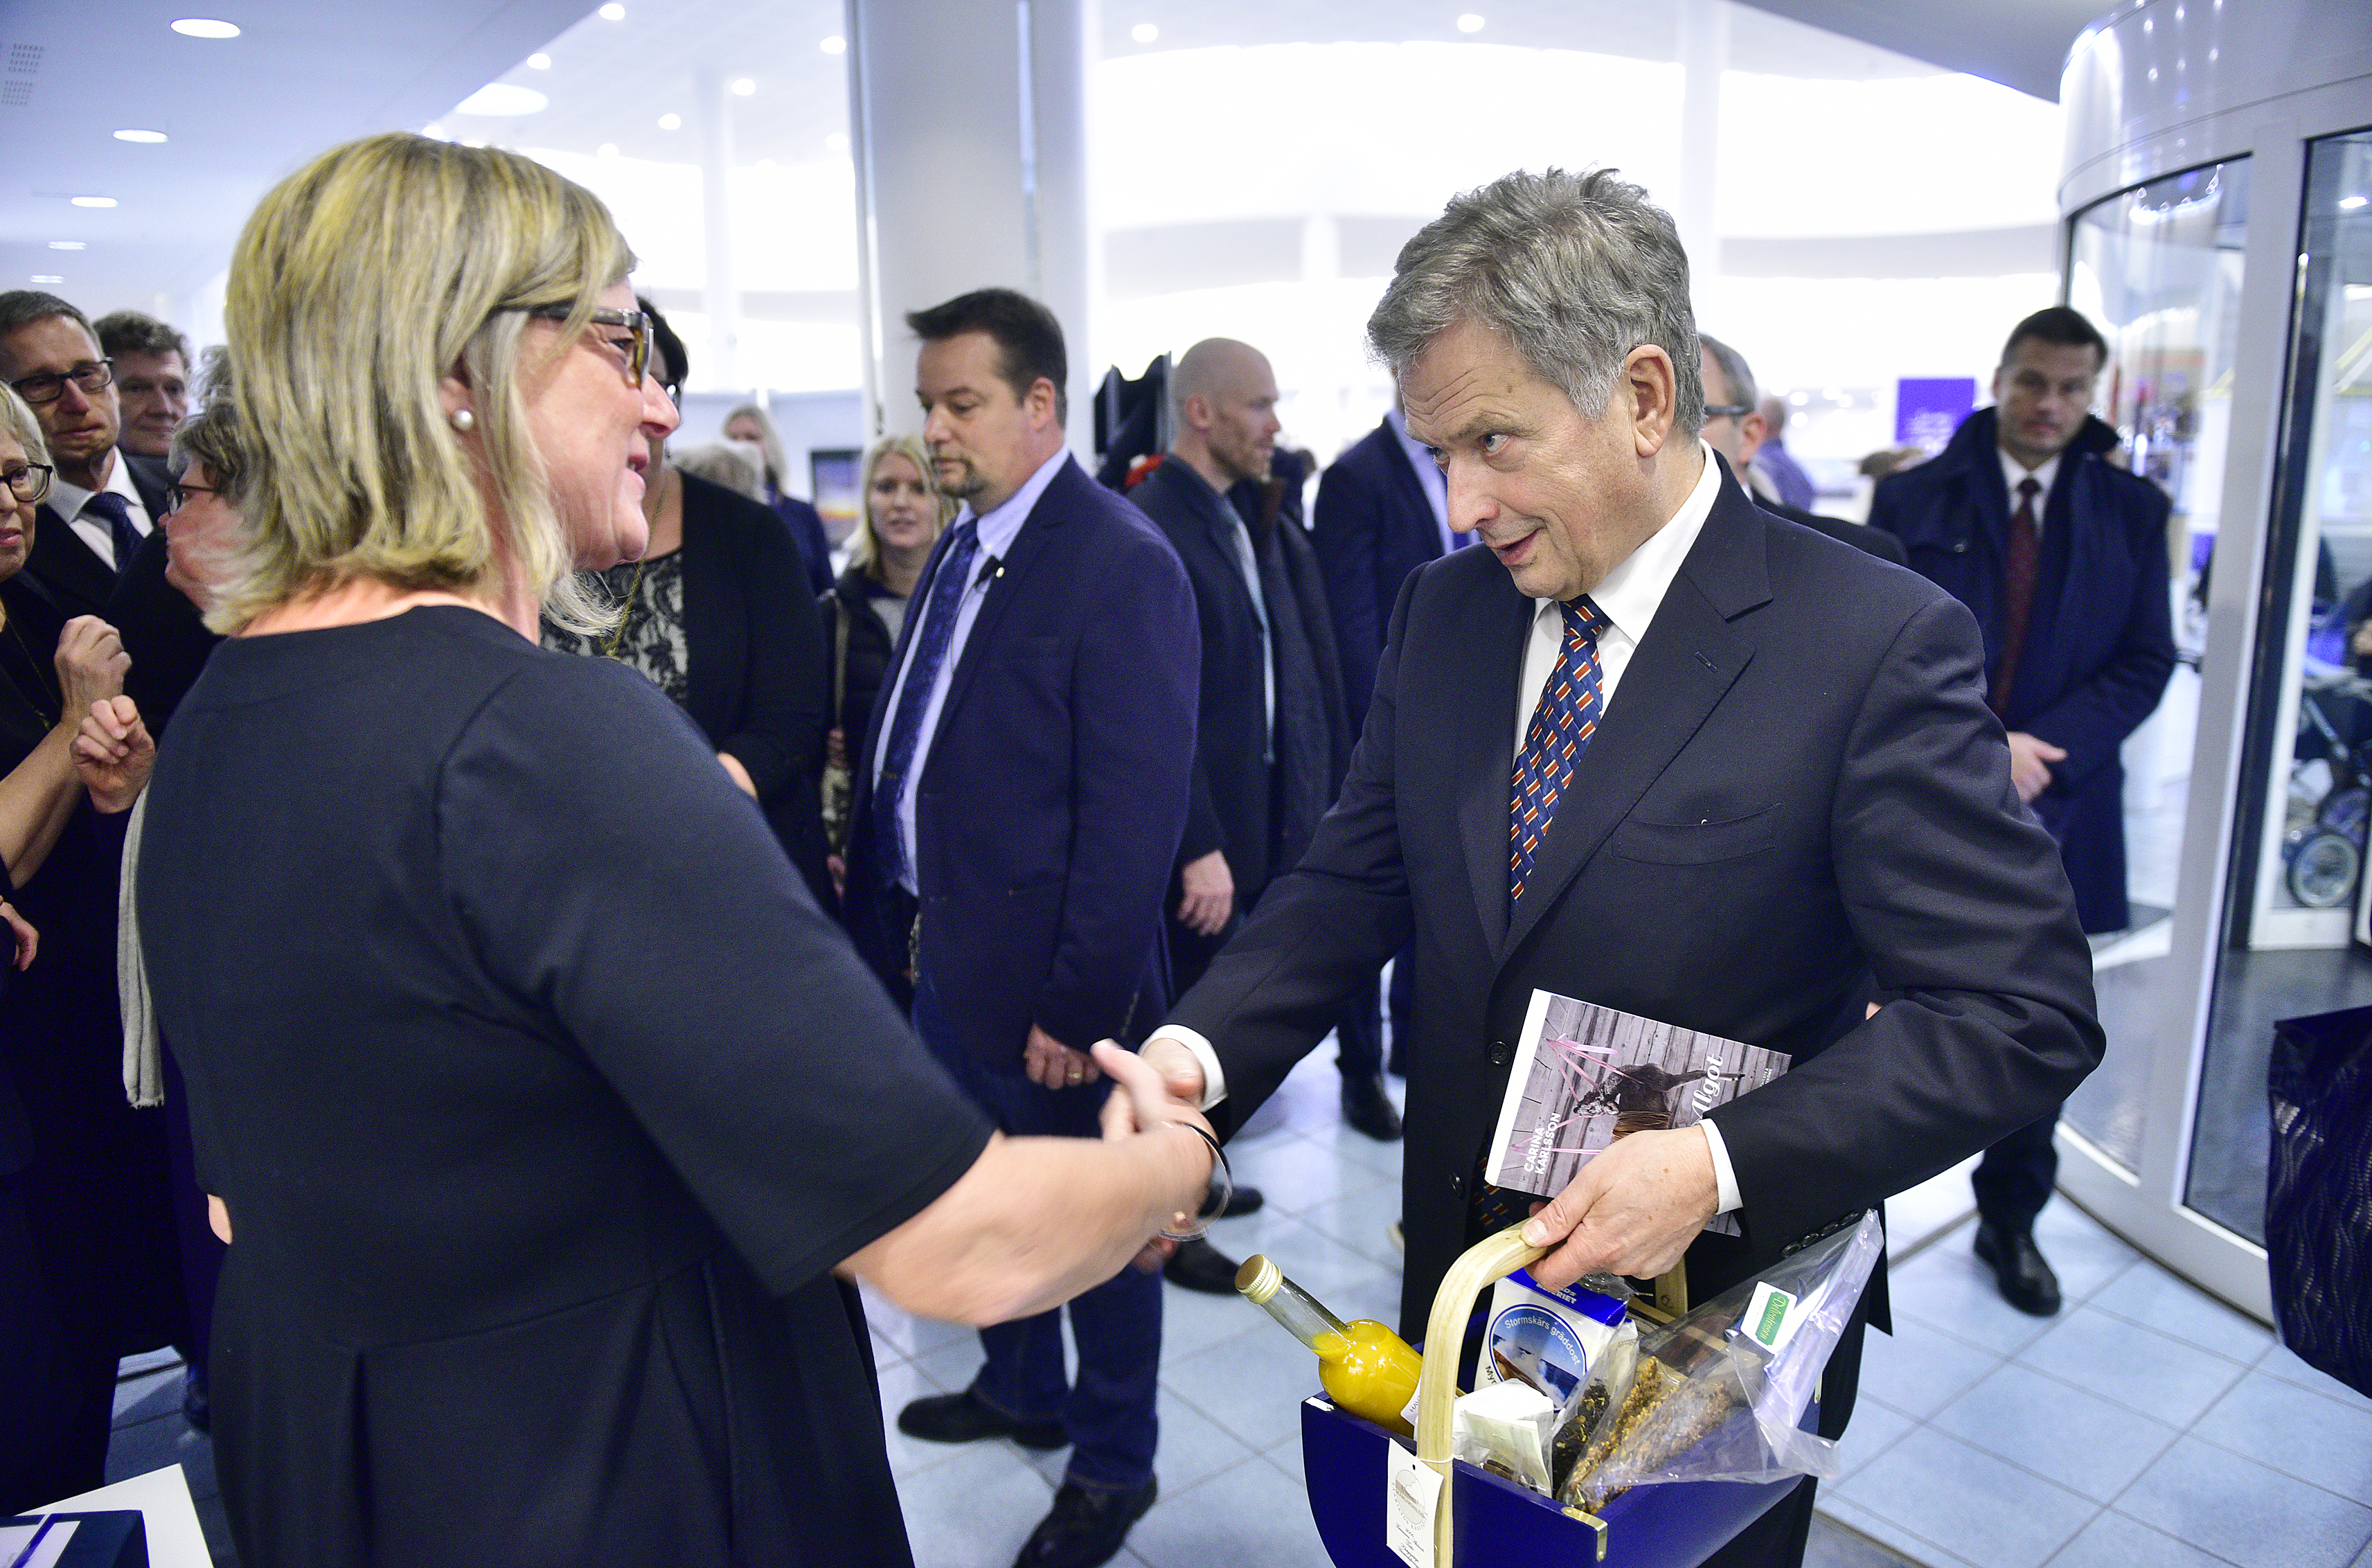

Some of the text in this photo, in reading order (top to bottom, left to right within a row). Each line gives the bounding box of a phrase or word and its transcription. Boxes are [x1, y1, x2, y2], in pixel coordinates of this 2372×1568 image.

[1691, 1053, 1723, 1126] Algot
[1524, 1128, 1544, 1172] CARINA
[1535, 1112, 1561, 1175] KARLSSON
[1505, 1316, 1581, 1366] Stormskärs gräddost
[1486, 1366, 1497, 1384] Myr
